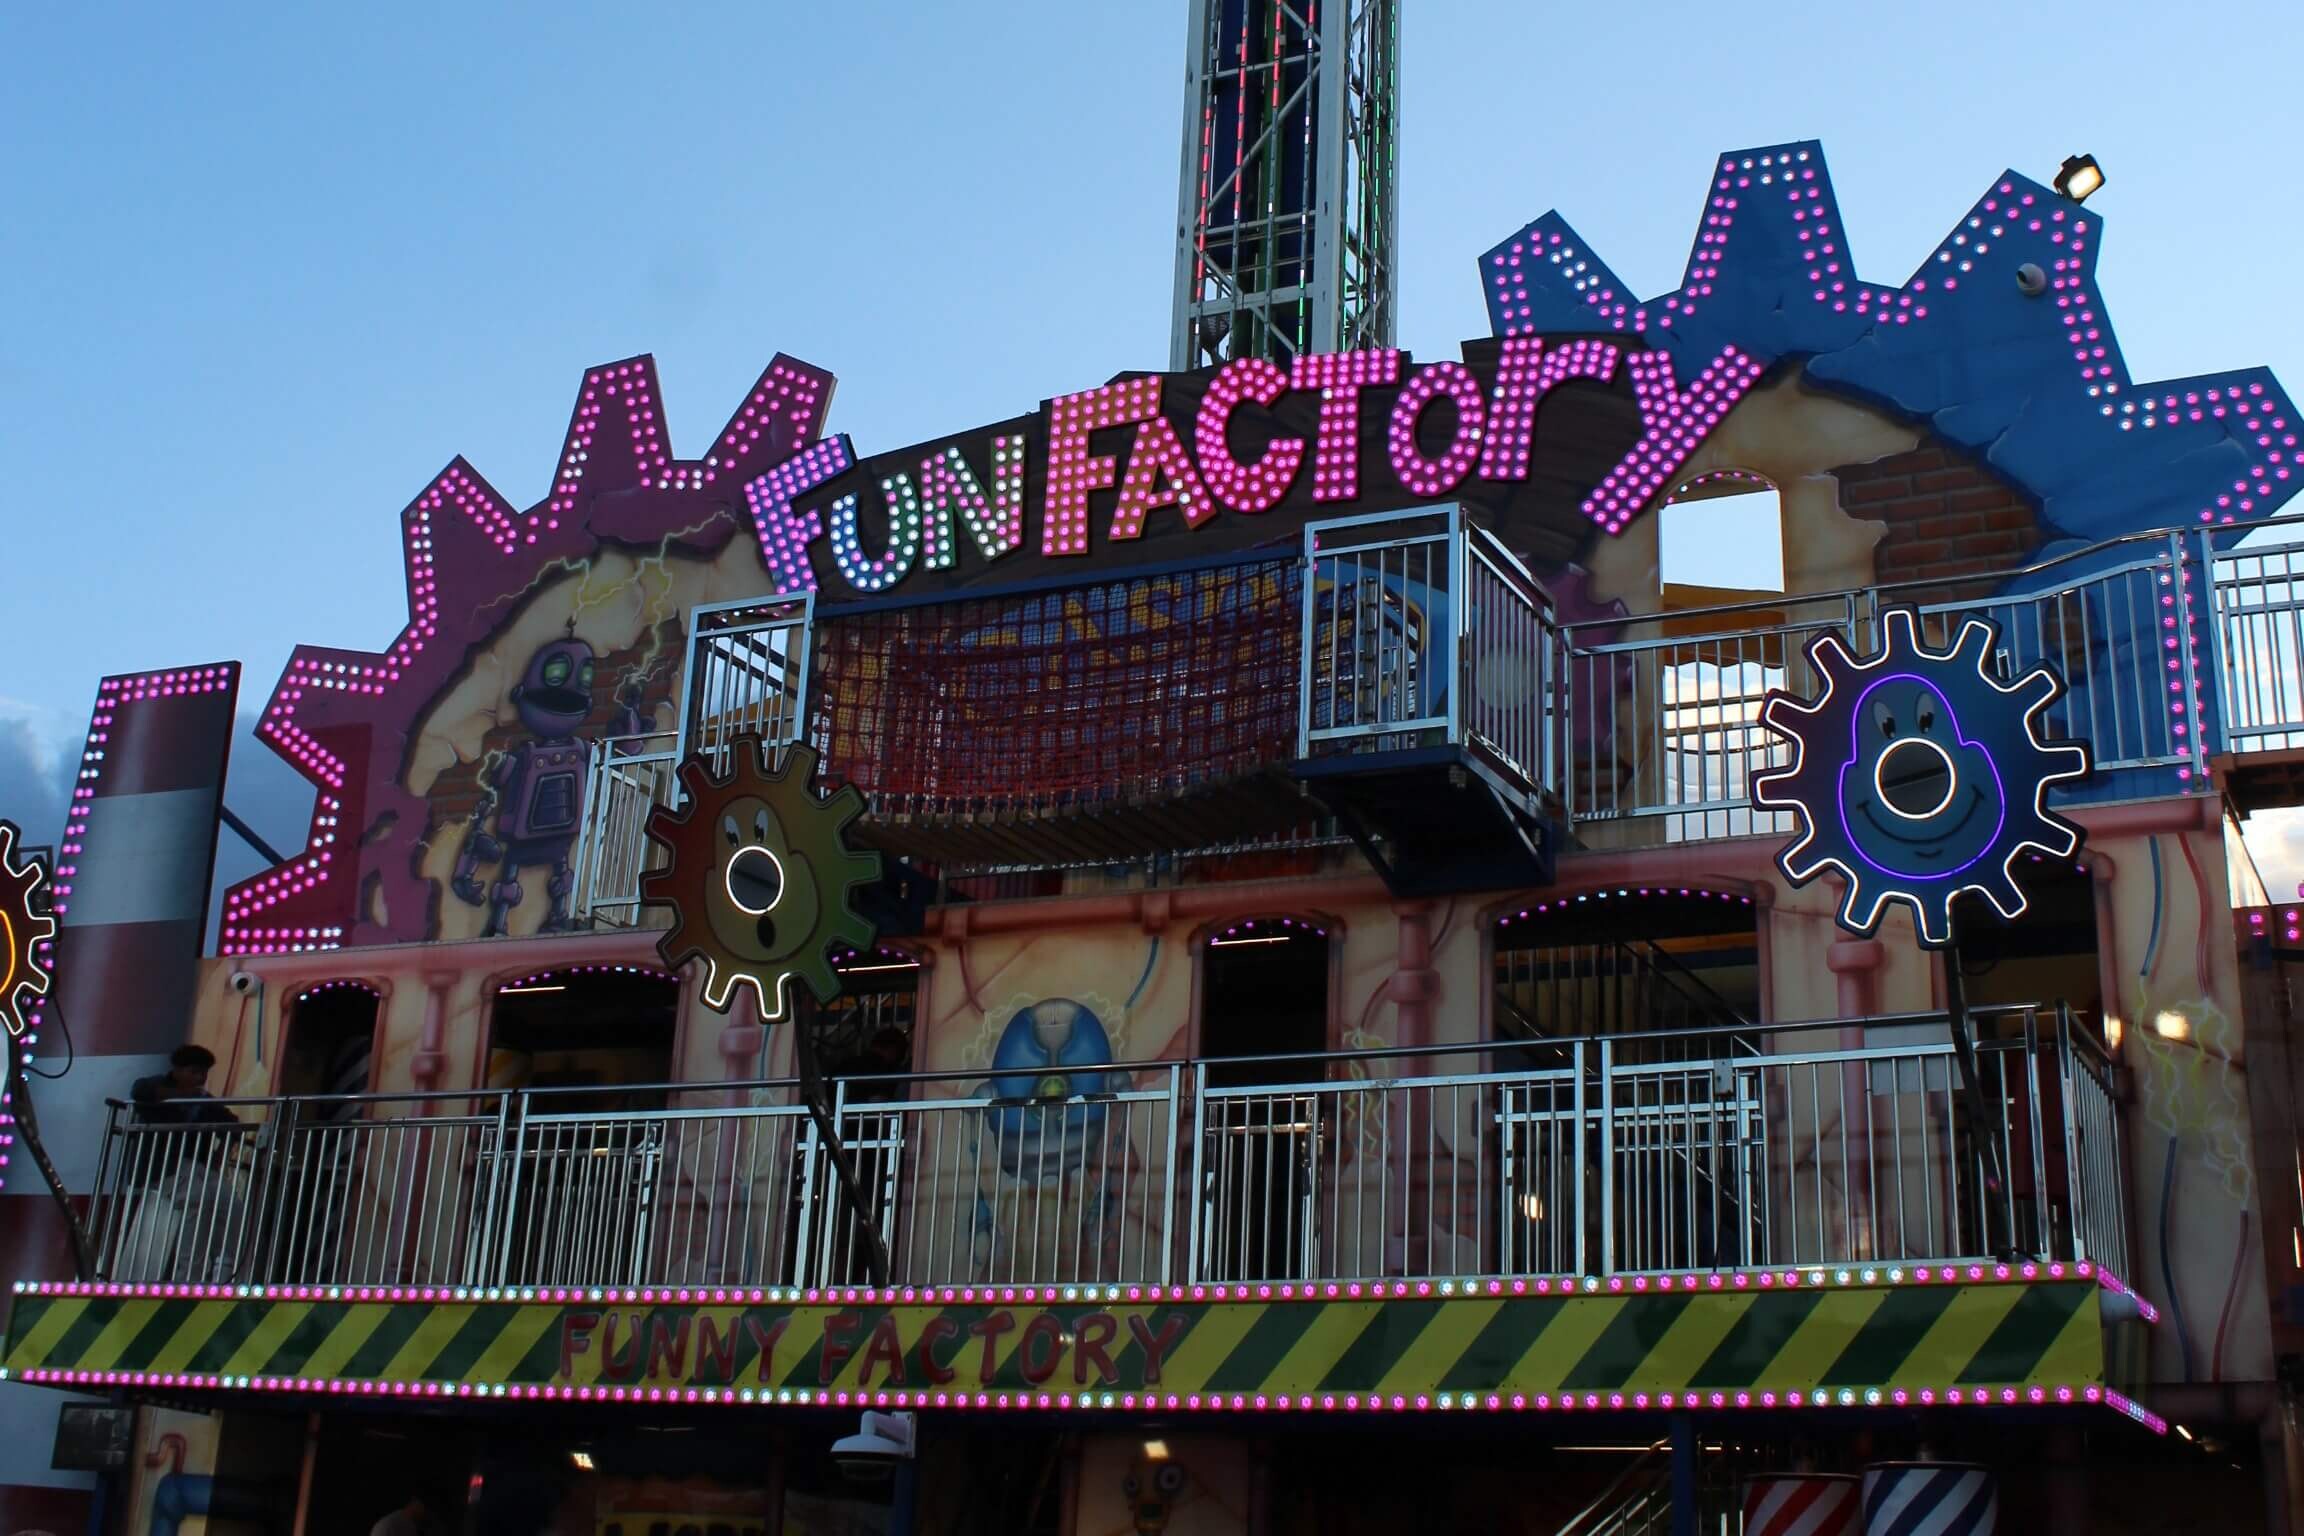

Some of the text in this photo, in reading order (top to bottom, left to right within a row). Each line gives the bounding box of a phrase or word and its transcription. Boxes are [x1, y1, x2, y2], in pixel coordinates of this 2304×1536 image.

[743, 434, 1026, 594] FUN
[559, 1310, 1190, 1387] FUNNY FACTORY
